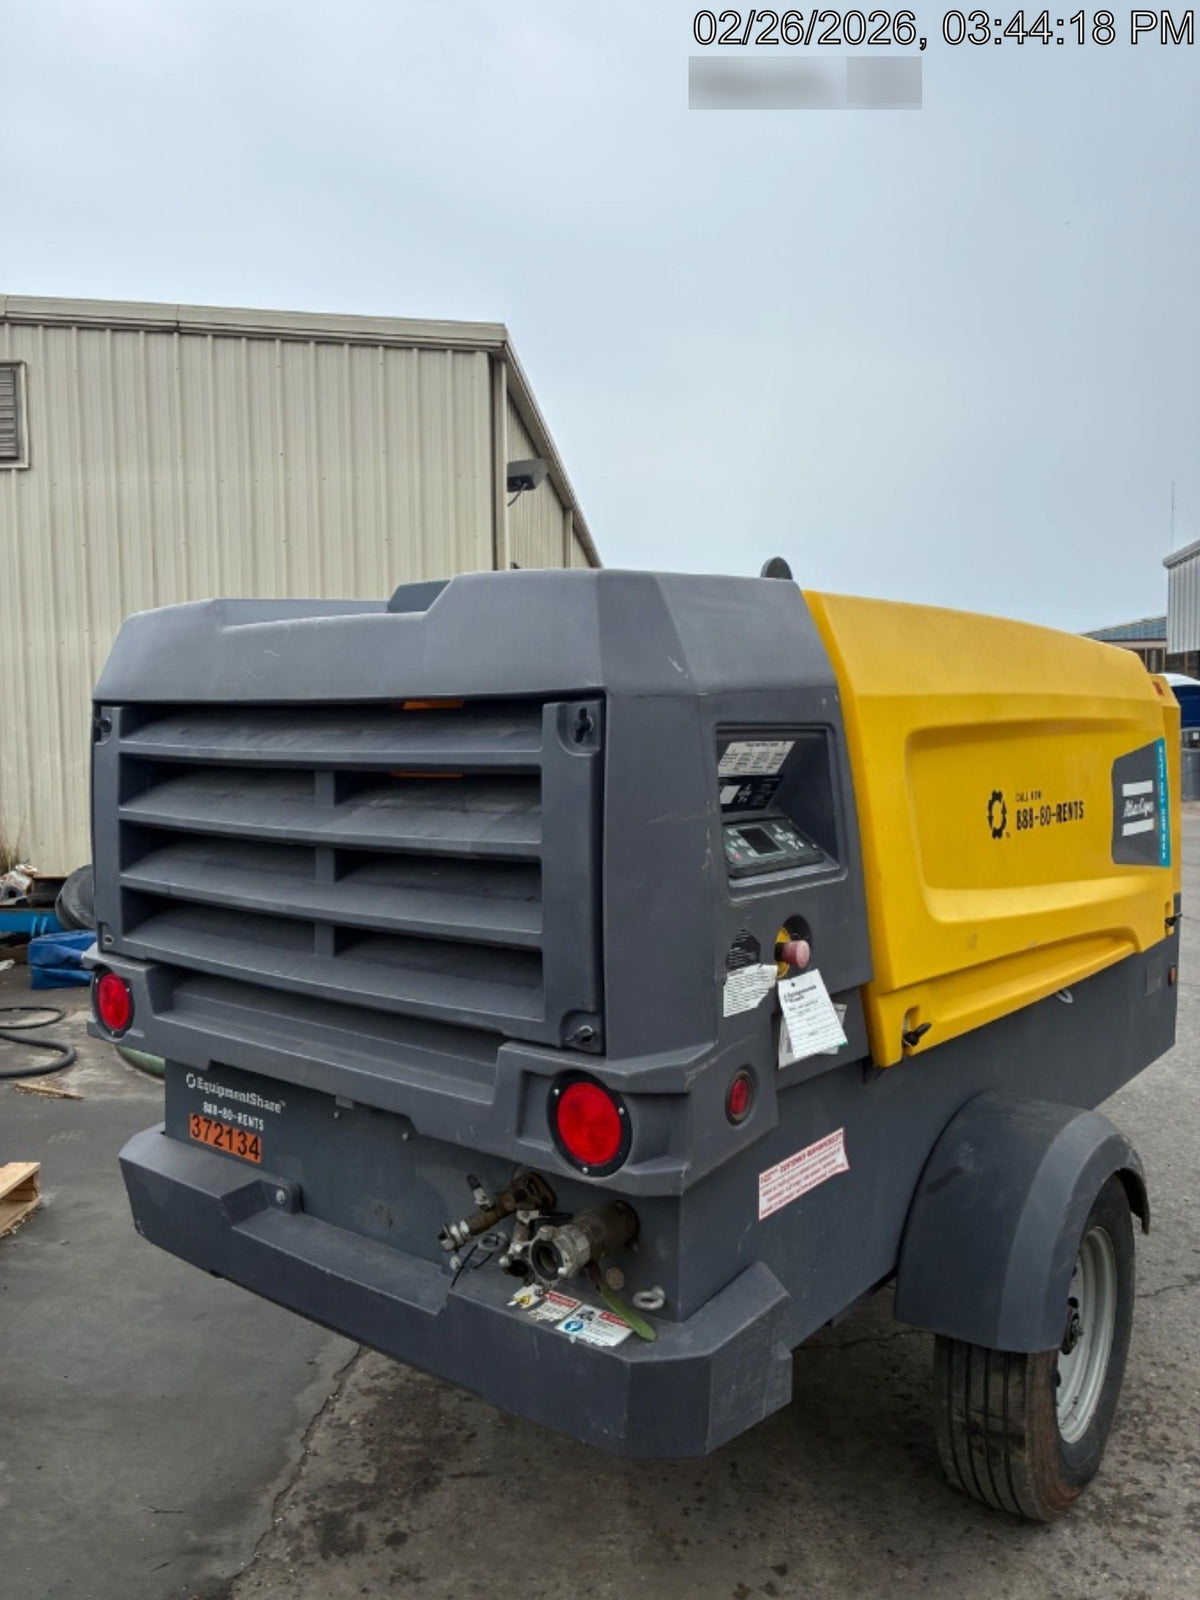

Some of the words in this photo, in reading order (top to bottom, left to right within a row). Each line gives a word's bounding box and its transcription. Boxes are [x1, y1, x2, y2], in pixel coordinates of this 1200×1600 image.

[1016, 800, 1084, 831] 888-80-RENTS
[196, 1077, 282, 1114] EquipmentShare
[202, 1101, 264, 1131] 888-80-RENTS
[191, 1114, 260, 1160] 372134
